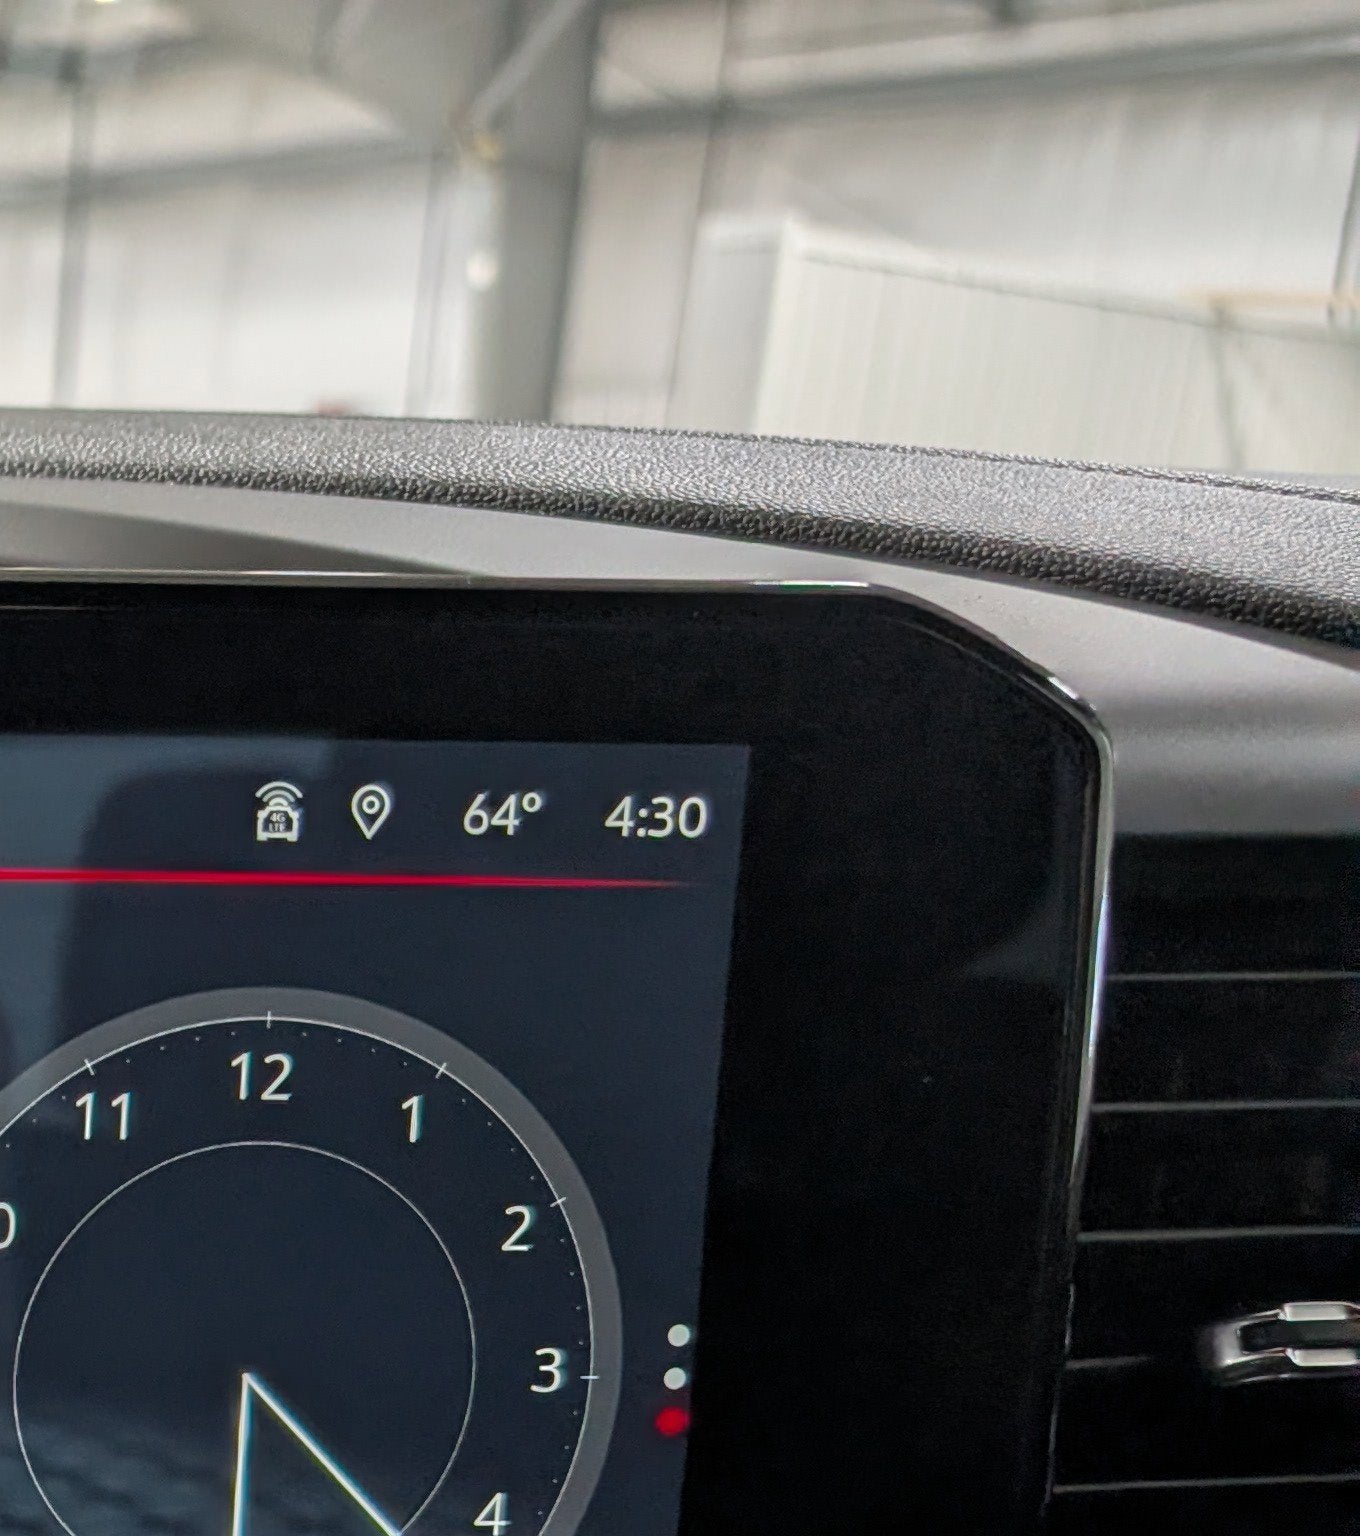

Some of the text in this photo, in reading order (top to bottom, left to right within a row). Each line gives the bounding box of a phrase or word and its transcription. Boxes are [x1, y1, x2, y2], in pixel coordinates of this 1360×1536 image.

[462, 790, 544, 837] 64°
[603, 794, 710, 840] 4:30
[229, 1051, 296, 1102] 12
[74, 1091, 133, 1141] 11
[400, 1094, 424, 1144] 1
[500, 1204, 536, 1253] 2
[529, 1346, 565, 1394] 3
